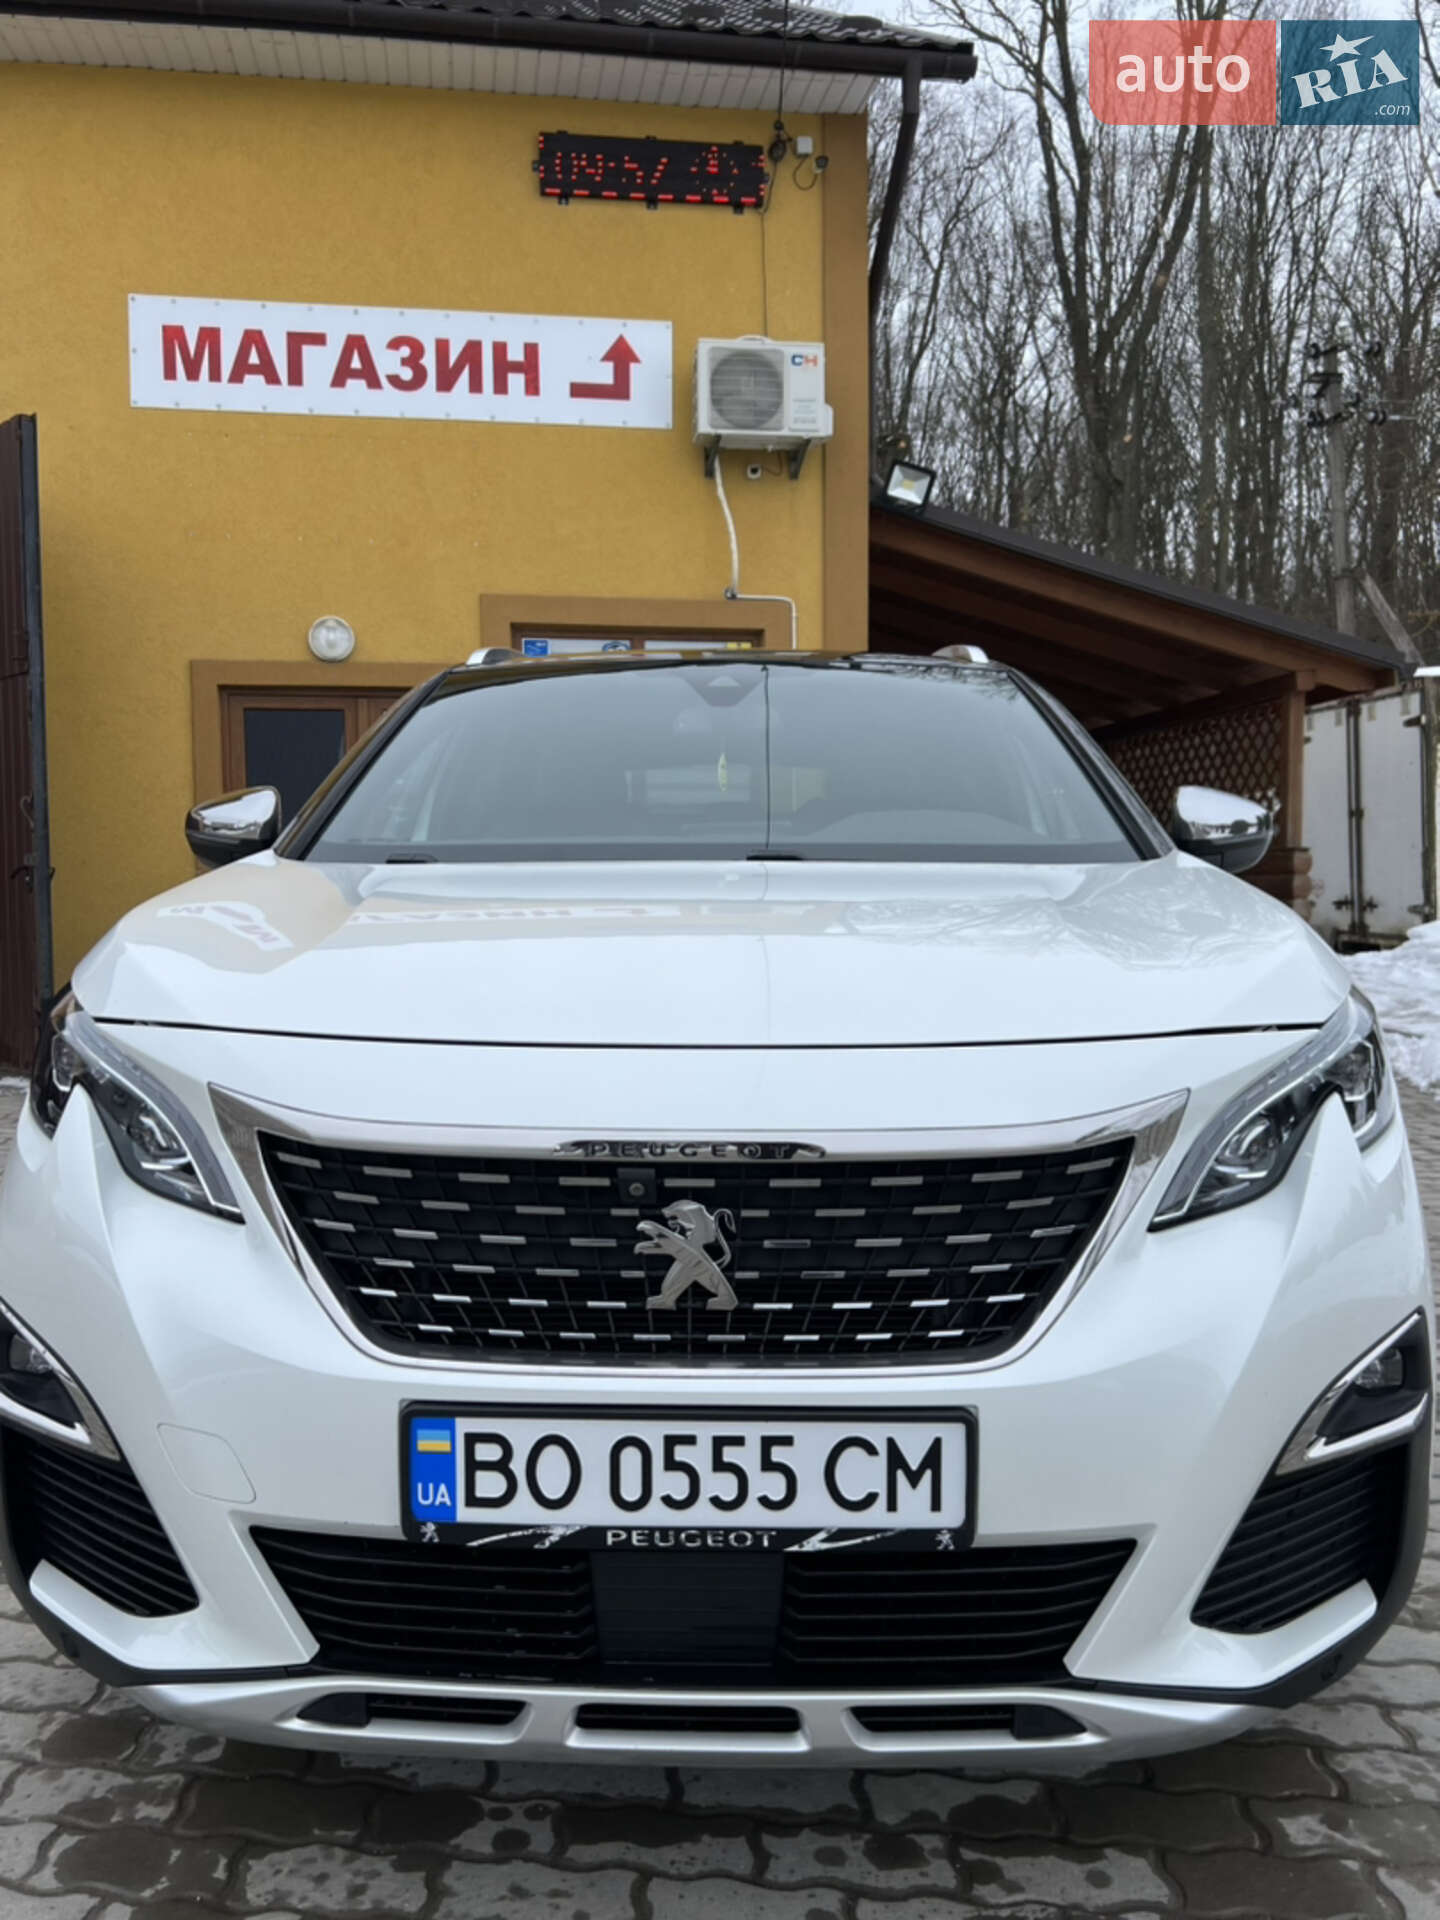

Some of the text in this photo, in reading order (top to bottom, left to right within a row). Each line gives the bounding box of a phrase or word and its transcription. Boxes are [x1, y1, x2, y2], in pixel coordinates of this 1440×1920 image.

[161, 324, 541, 397] МАГАЗИН
[588, 1143, 789, 1160] PEUGEOT
[463, 1432, 943, 1513] BO 0555 CM
[417, 1482, 452, 1507] UA
[606, 1529, 777, 1548] PEUGEOT
